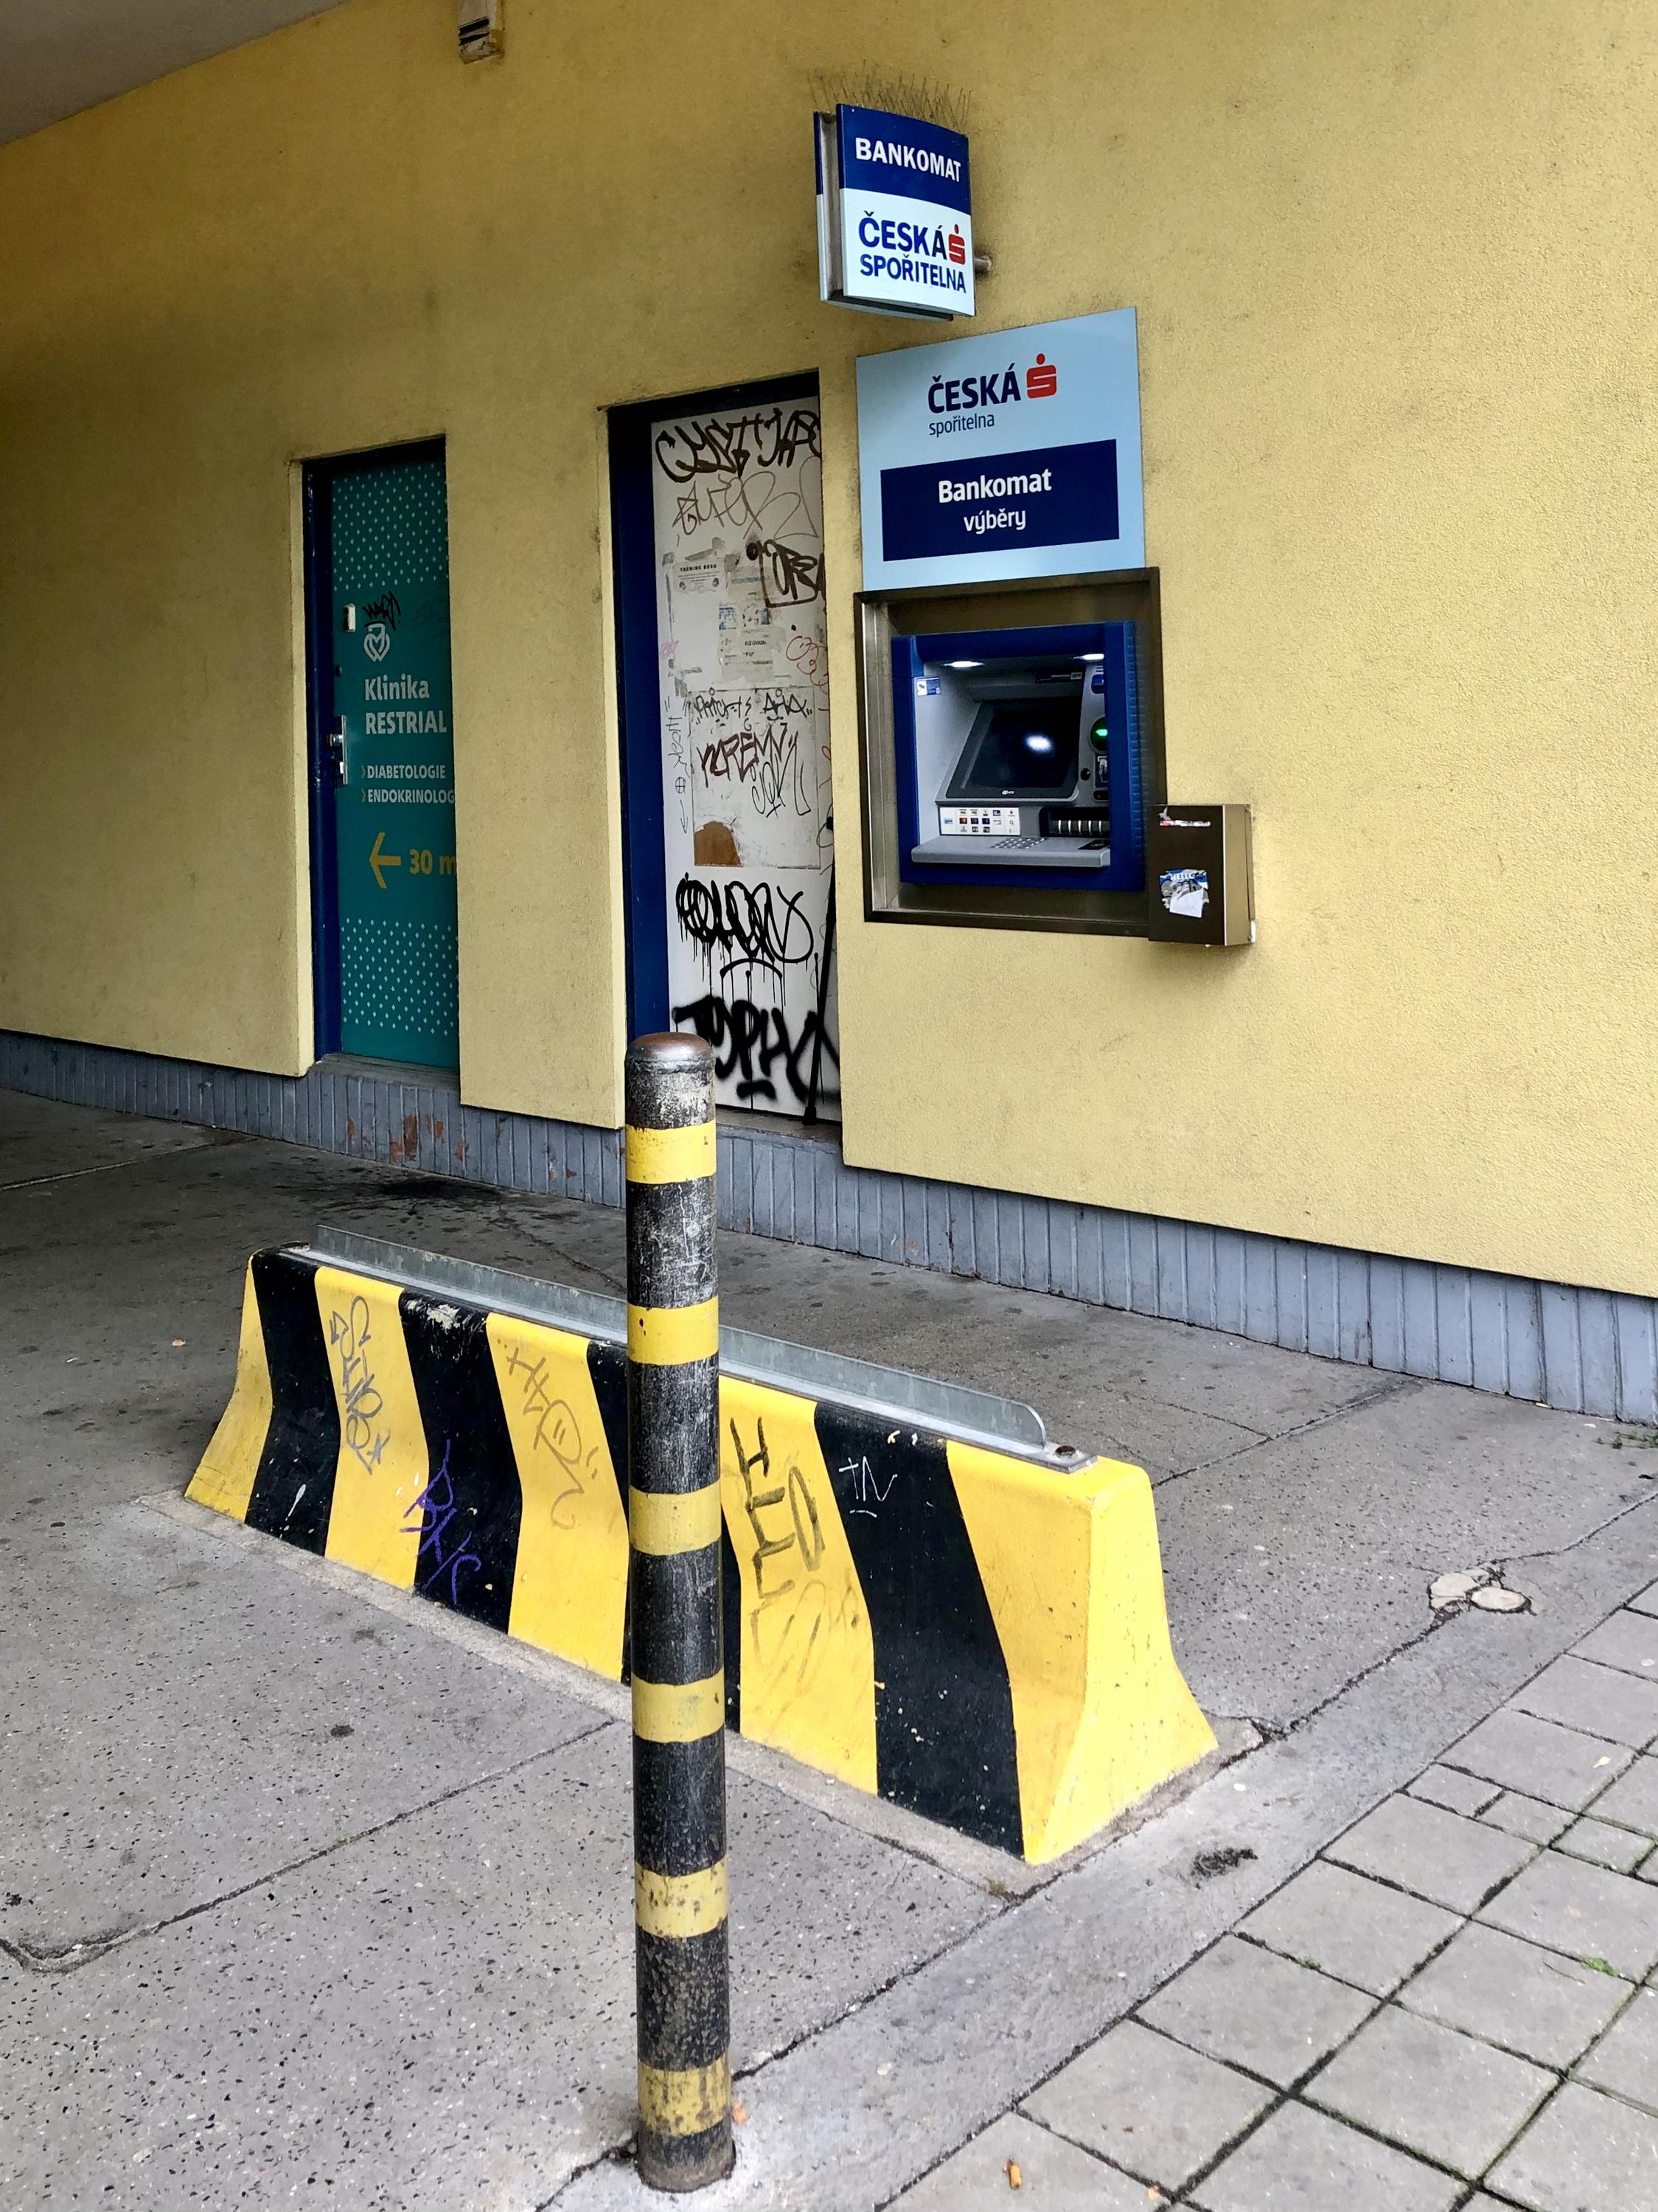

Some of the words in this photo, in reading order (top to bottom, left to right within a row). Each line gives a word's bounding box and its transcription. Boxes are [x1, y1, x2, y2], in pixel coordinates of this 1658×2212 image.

[854, 137, 961, 183] BANKOMAT
[858, 210, 947, 260] ČESKÁ
[860, 254, 966, 293] SPOŘITELNA
[927, 363, 1022, 414] ČESKÁ
[929, 413, 995, 437] spořitelna
[938, 468, 1052, 504] Bankomat
[963, 509, 1027, 535] výběry
[364, 674, 430, 700] Klinika
[366, 710, 447, 734] RESTRIAL
[367, 764, 446, 779] DIABETOLOGIE
[367, 787, 455, 804] ENDOKRINOLOG
[409, 848, 433, 874] 30
